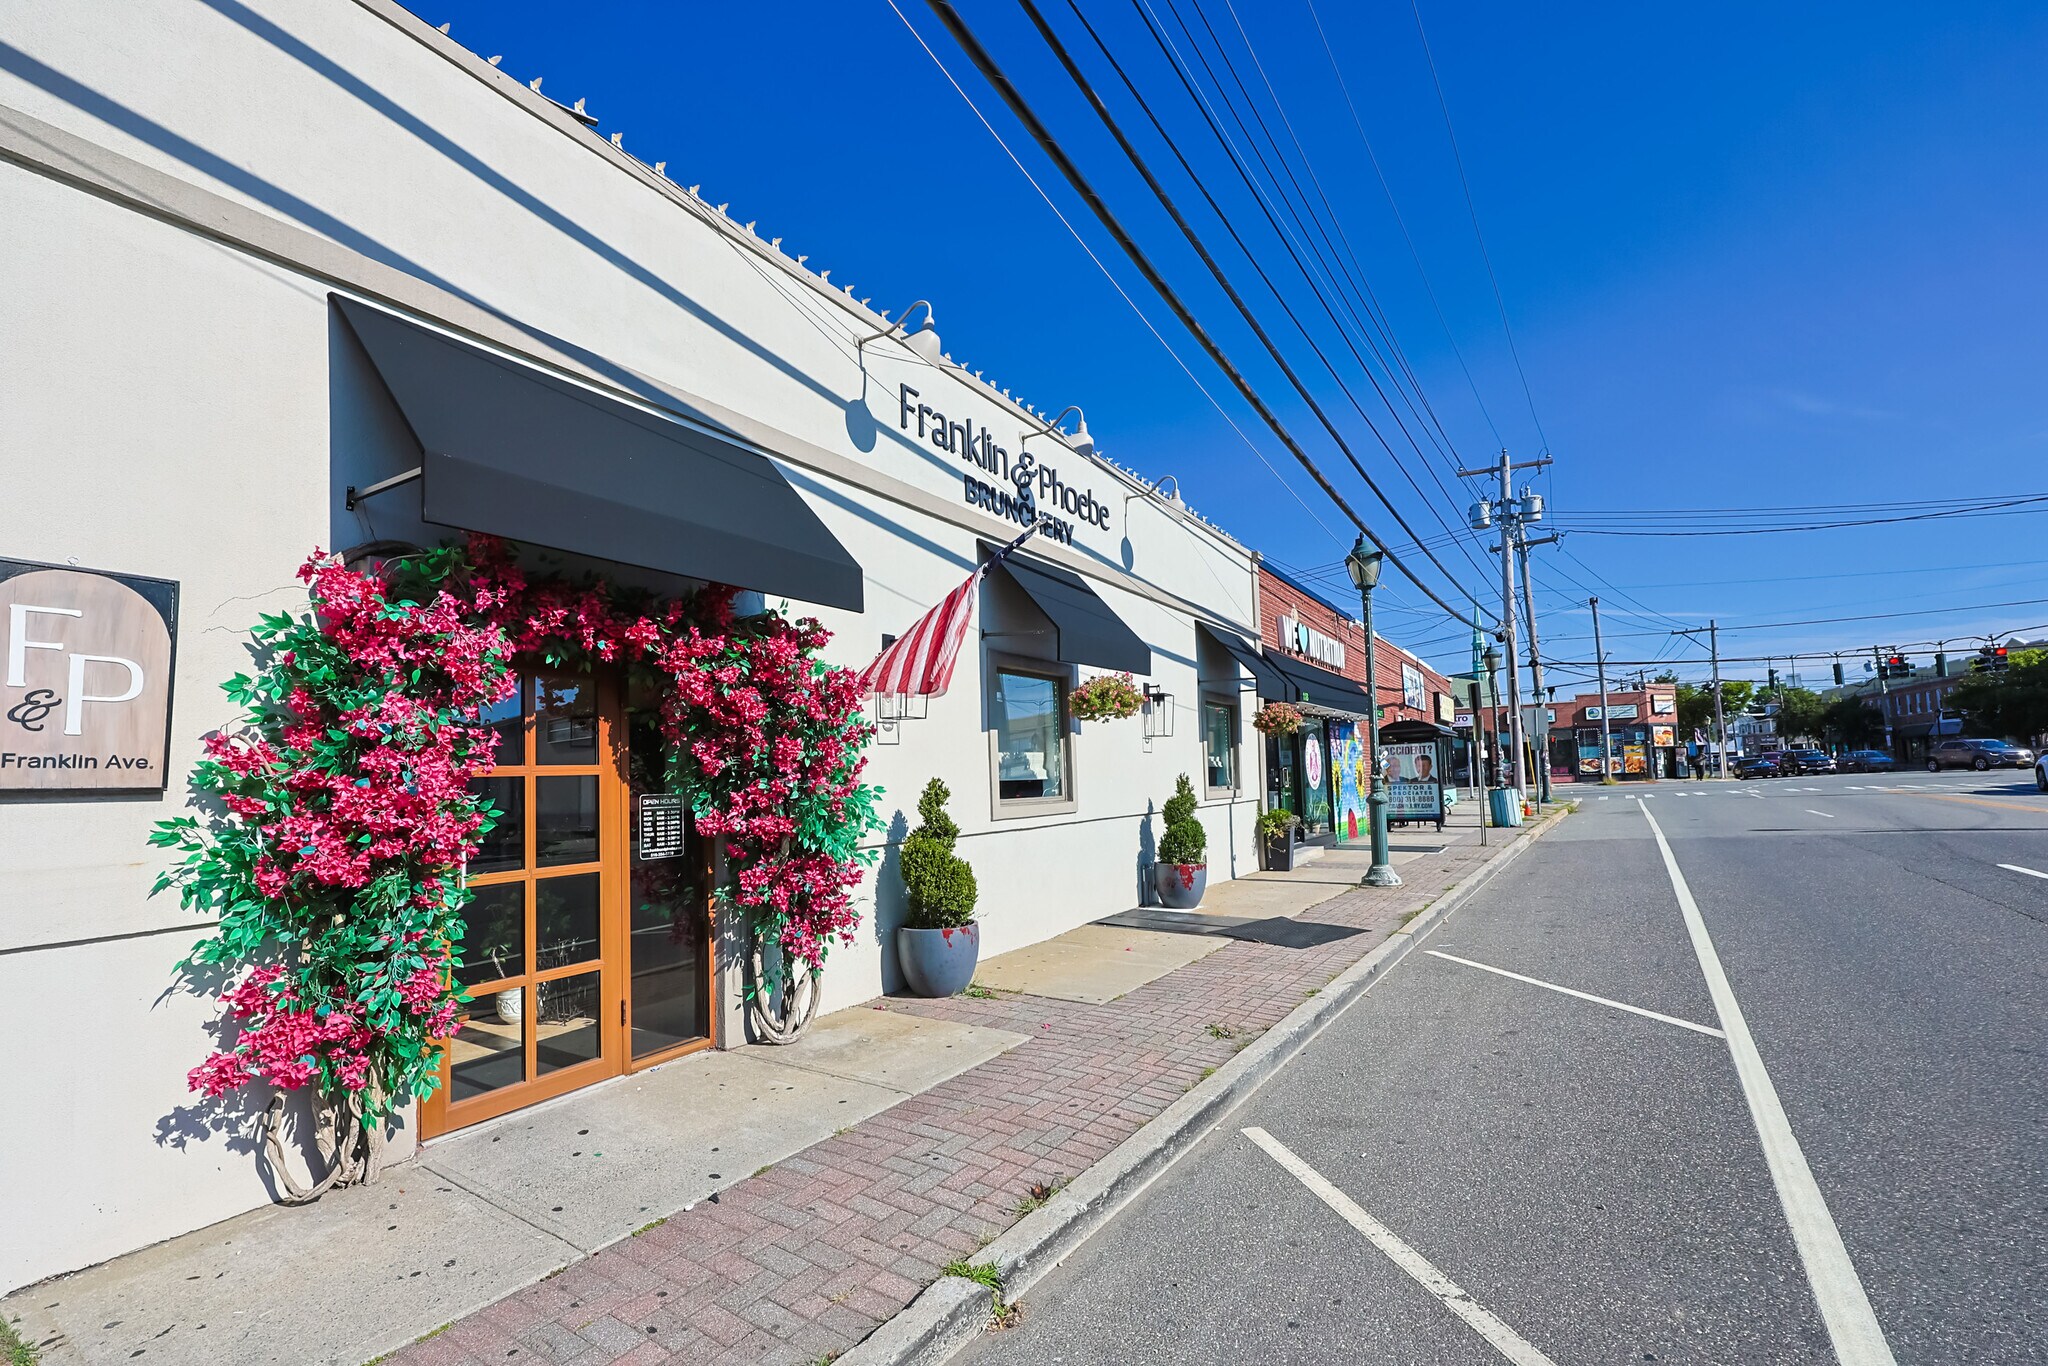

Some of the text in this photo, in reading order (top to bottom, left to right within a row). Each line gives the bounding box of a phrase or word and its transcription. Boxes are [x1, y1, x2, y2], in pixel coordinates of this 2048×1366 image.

[900, 383, 1110, 531] Franklin & Phoebe
[7, 603, 83, 686] F
[1280, 615, 1345, 669] WE NUTRITION
[7, 689, 62, 731] &
[64, 653, 144, 735] P
[1, 753, 154, 770] Franklin Ave.
